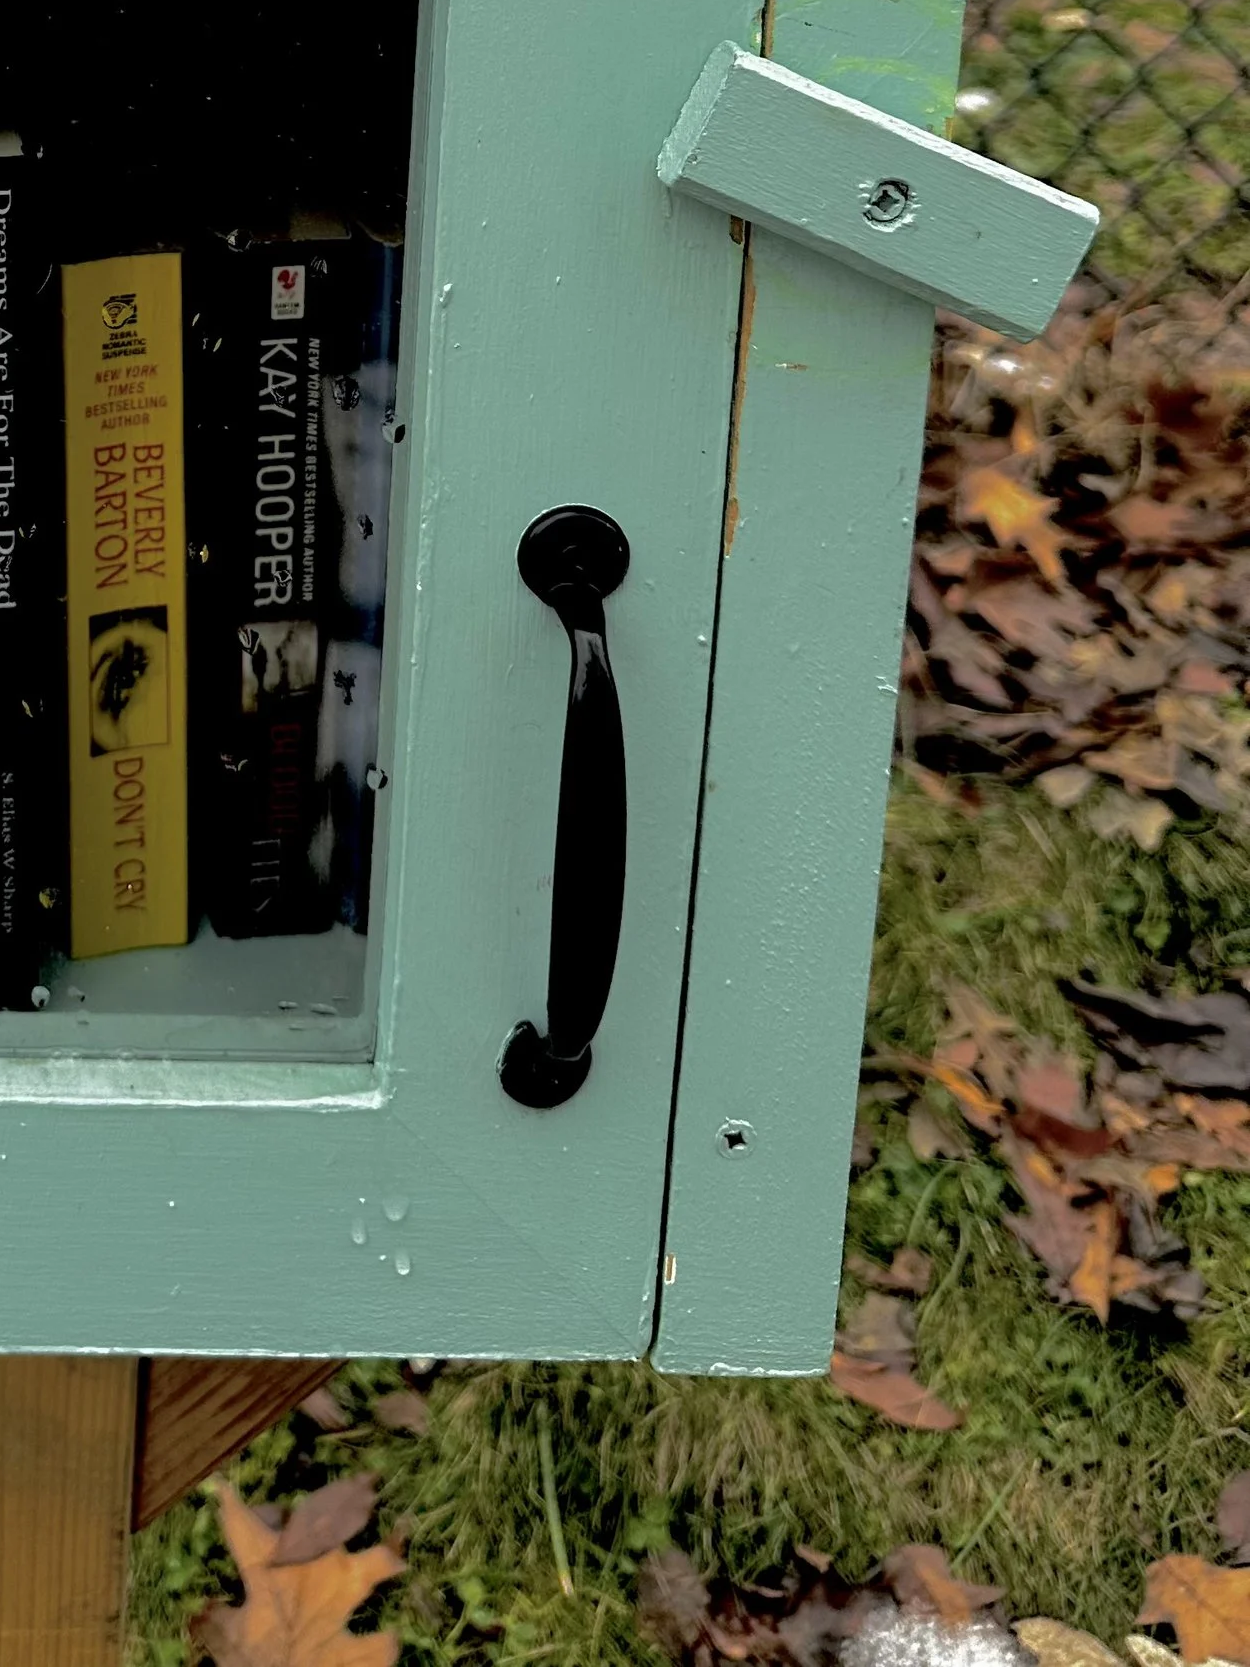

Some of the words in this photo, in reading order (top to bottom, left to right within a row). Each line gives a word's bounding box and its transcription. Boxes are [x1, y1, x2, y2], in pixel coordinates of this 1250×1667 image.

[94, 367, 121, 384] NEW
[126, 363, 159, 379] YORK
[257, 337, 299, 419] KAY
[308, 337, 321, 370] NEW
[85, 395, 168, 419] BESTSELLING
[107, 381, 145, 397] TIMES
[306, 374, 320, 408] YORK
[100, 412, 150, 431] AUTHOR
[305, 411, 319, 452] TIMES
[93, 442, 129, 591] BARTON
[132, 443, 166, 579] BEVERLY
[253, 434, 298, 607] HOOPER
[303, 455, 318, 545] BESTSELLING
[301, 547, 316, 603] AUTHOR
[112, 754, 146, 850] DON'T
[113, 858, 147, 915] CRY
